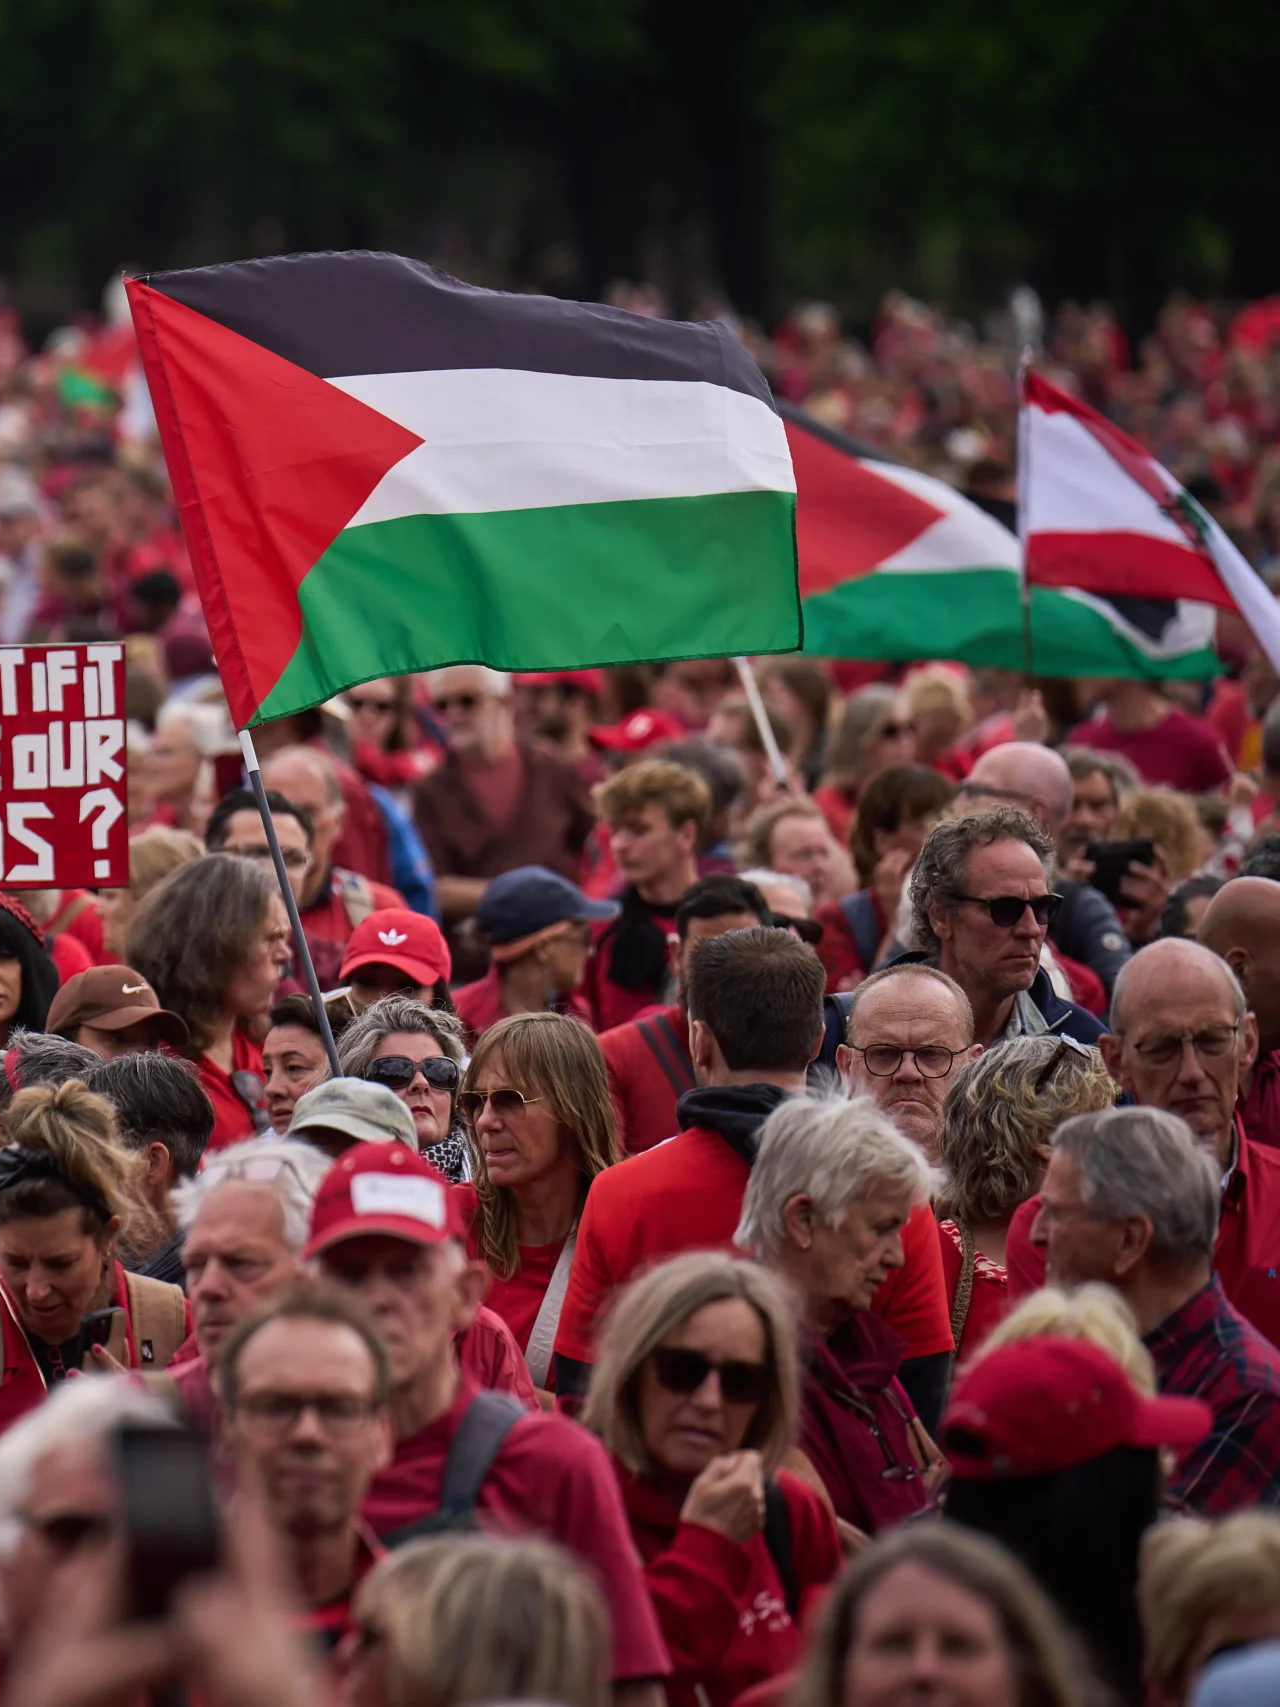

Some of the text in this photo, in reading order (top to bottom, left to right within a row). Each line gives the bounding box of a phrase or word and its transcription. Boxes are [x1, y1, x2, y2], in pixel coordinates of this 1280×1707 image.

[31, 650, 78, 712] IF
[83, 645, 122, 717] IT
[11, 719, 124, 790] OUR
